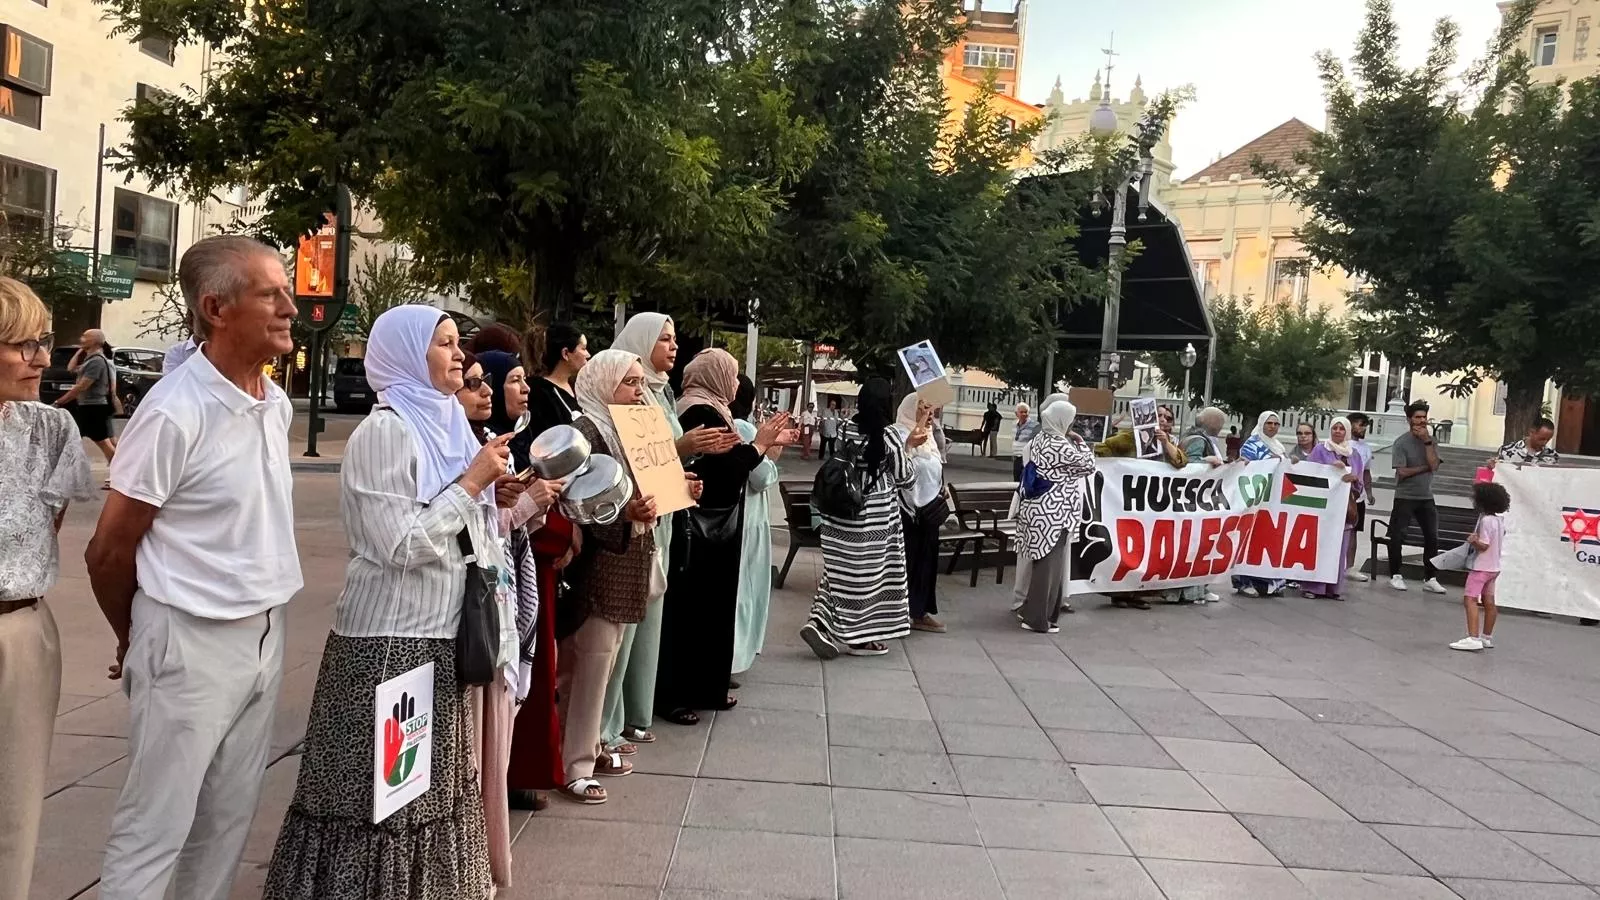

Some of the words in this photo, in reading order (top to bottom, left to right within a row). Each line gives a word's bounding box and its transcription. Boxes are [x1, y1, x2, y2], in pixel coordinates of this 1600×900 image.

[102, 267, 117, 276] San
[100, 275, 132, 285] Lorenzo
[1122, 474, 1231, 512] HUESCA
[1576, 550, 1600, 565] Ca
[406, 714, 428, 735] STOP
